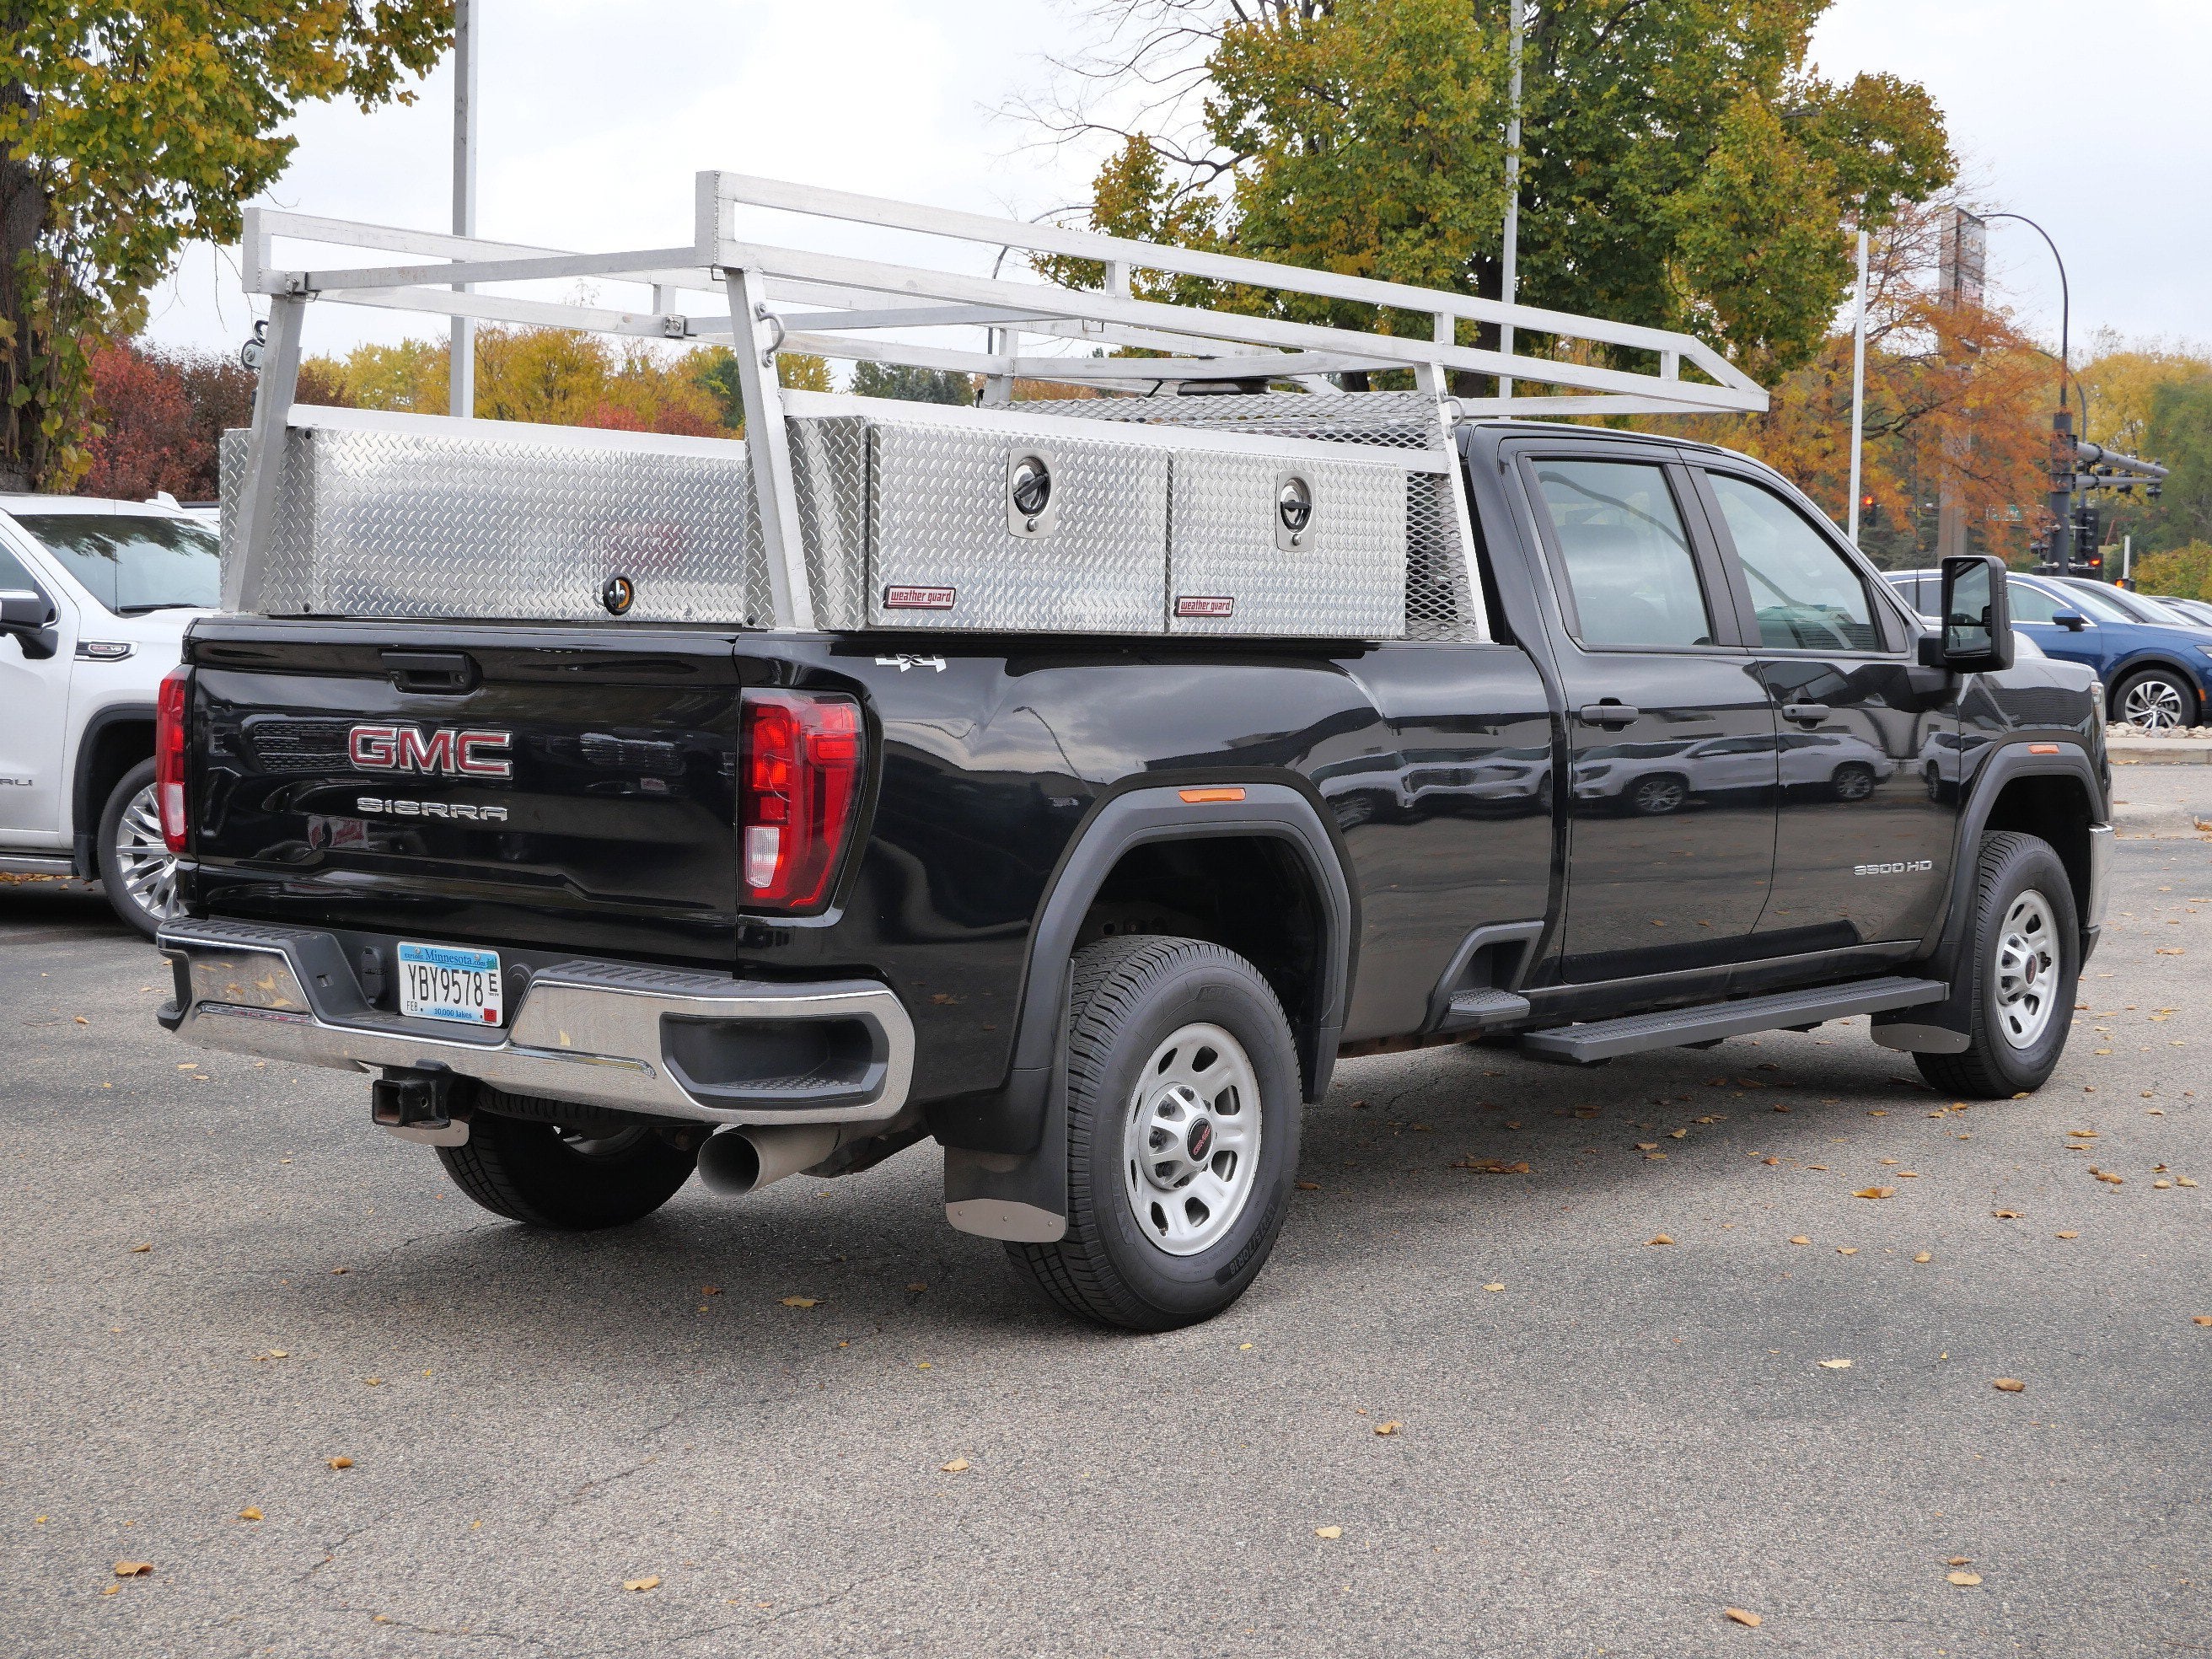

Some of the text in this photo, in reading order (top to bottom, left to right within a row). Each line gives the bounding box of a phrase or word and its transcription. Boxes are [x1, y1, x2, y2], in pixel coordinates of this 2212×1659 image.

[890, 590, 952, 603] weather guard
[1180, 600, 1230, 611] weather guard
[348, 724, 513, 780] GMC
[357, 797, 507, 821] SIERRA
[408, 964, 497, 1007] YBY9578 E
[406, 1001, 418, 1012] FEB
[434, 1007, 472, 1019] 10,000 lakes
